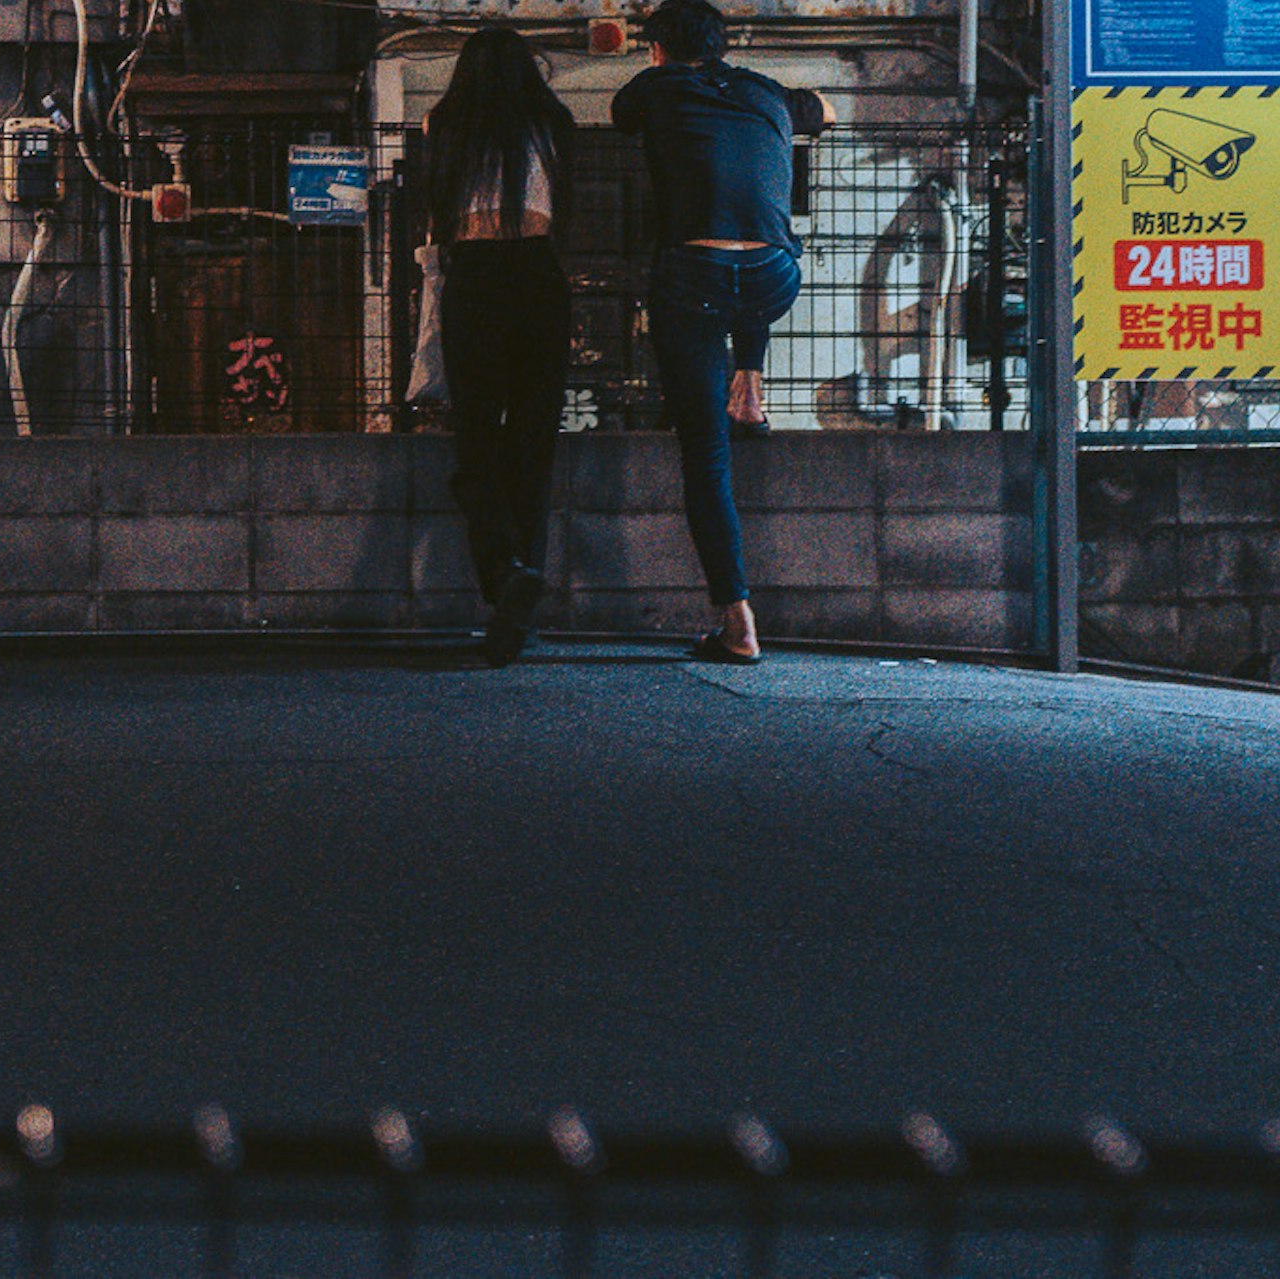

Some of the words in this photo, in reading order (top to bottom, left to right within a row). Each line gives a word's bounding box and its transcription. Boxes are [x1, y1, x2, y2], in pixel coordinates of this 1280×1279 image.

[1132, 211, 1248, 235] 防犯カメラ
[1127, 244, 1251, 287] 24時間
[1118, 302, 1262, 351] 監視中
